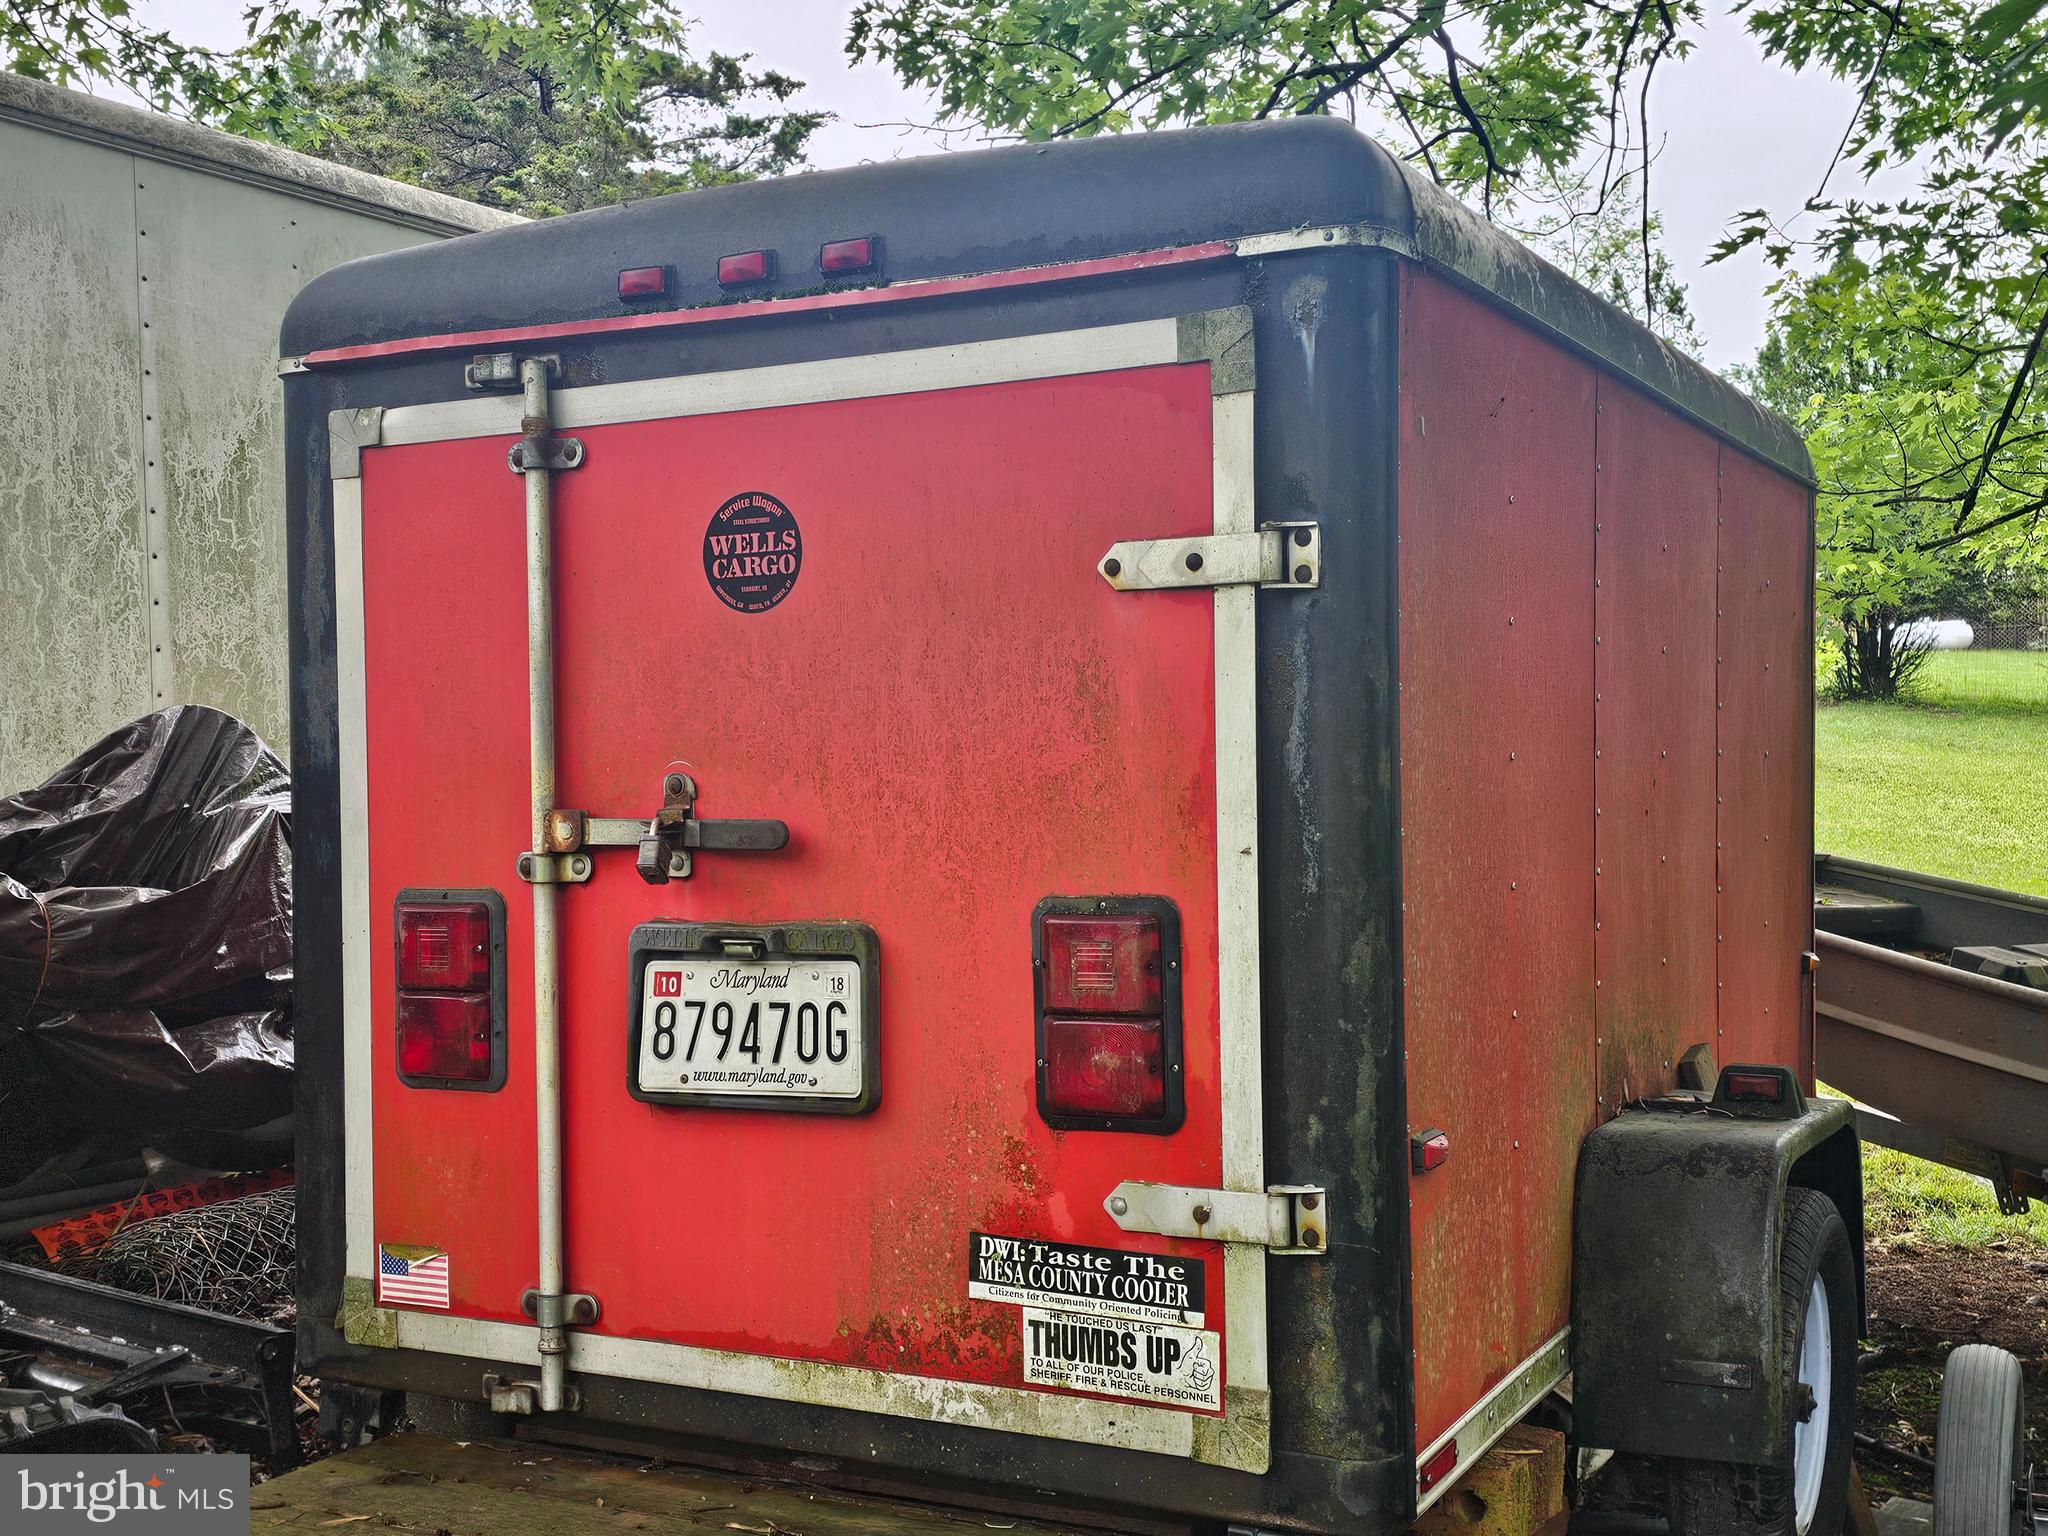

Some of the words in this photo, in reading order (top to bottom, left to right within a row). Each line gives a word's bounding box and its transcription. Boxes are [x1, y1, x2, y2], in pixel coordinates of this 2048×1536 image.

[719, 498, 750, 522] Service
[752, 495, 783, 518] Wagon
[708, 529, 797, 556] WELLS
[712, 553, 797, 579] CARGO
[660, 976, 678, 993] 10
[709, 967, 791, 996] Maryland
[830, 976, 844, 991] 18
[653, 1000, 848, 1064] 879470G
[693, 1066, 808, 1088] www.maryland.gov
[979, 1236, 1026, 1262] DWI:
[1028, 1243, 1112, 1272] Taste
[1123, 1255, 1185, 1281] The
[978, 1257, 1026, 1286] MESA
[1028, 1264, 1109, 1297] COUNTY
[1111, 1275, 1190, 1308] COOLER
[988, 1285, 1025, 1299] Citizens
[1026, 1290, 1040, 1301] for
[1041, 1293, 1098, 1311] Community
[1099, 1301, 1141, 1316] Oriented
[1144, 1307, 1184, 1324] Policing
[1065, 1314, 1113, 1329] TOUCHED
[1115, 1320, 1130, 1331] US
[1028, 1318, 1138, 1370] THUMBS
[1146, 1334, 1181, 1376] UP
[1030, 1357, 1043, 1368] TO
[1046, 1360, 1064, 1371] ALL
[1066, 1363, 1080, 1373] OF
[1083, 1364, 1105, 1377] OUR
[1107, 1368, 1147, 1384] POLICE,
[1030, 1367, 1073, 1384] SHERIFF,
[1075, 1374, 1097, 1386] FIRE
[1100, 1378, 1107, 1388] &
[1110, 1380, 1152, 1395] RESCUE
[1154, 1386, 1217, 1405] PERSONNEL
